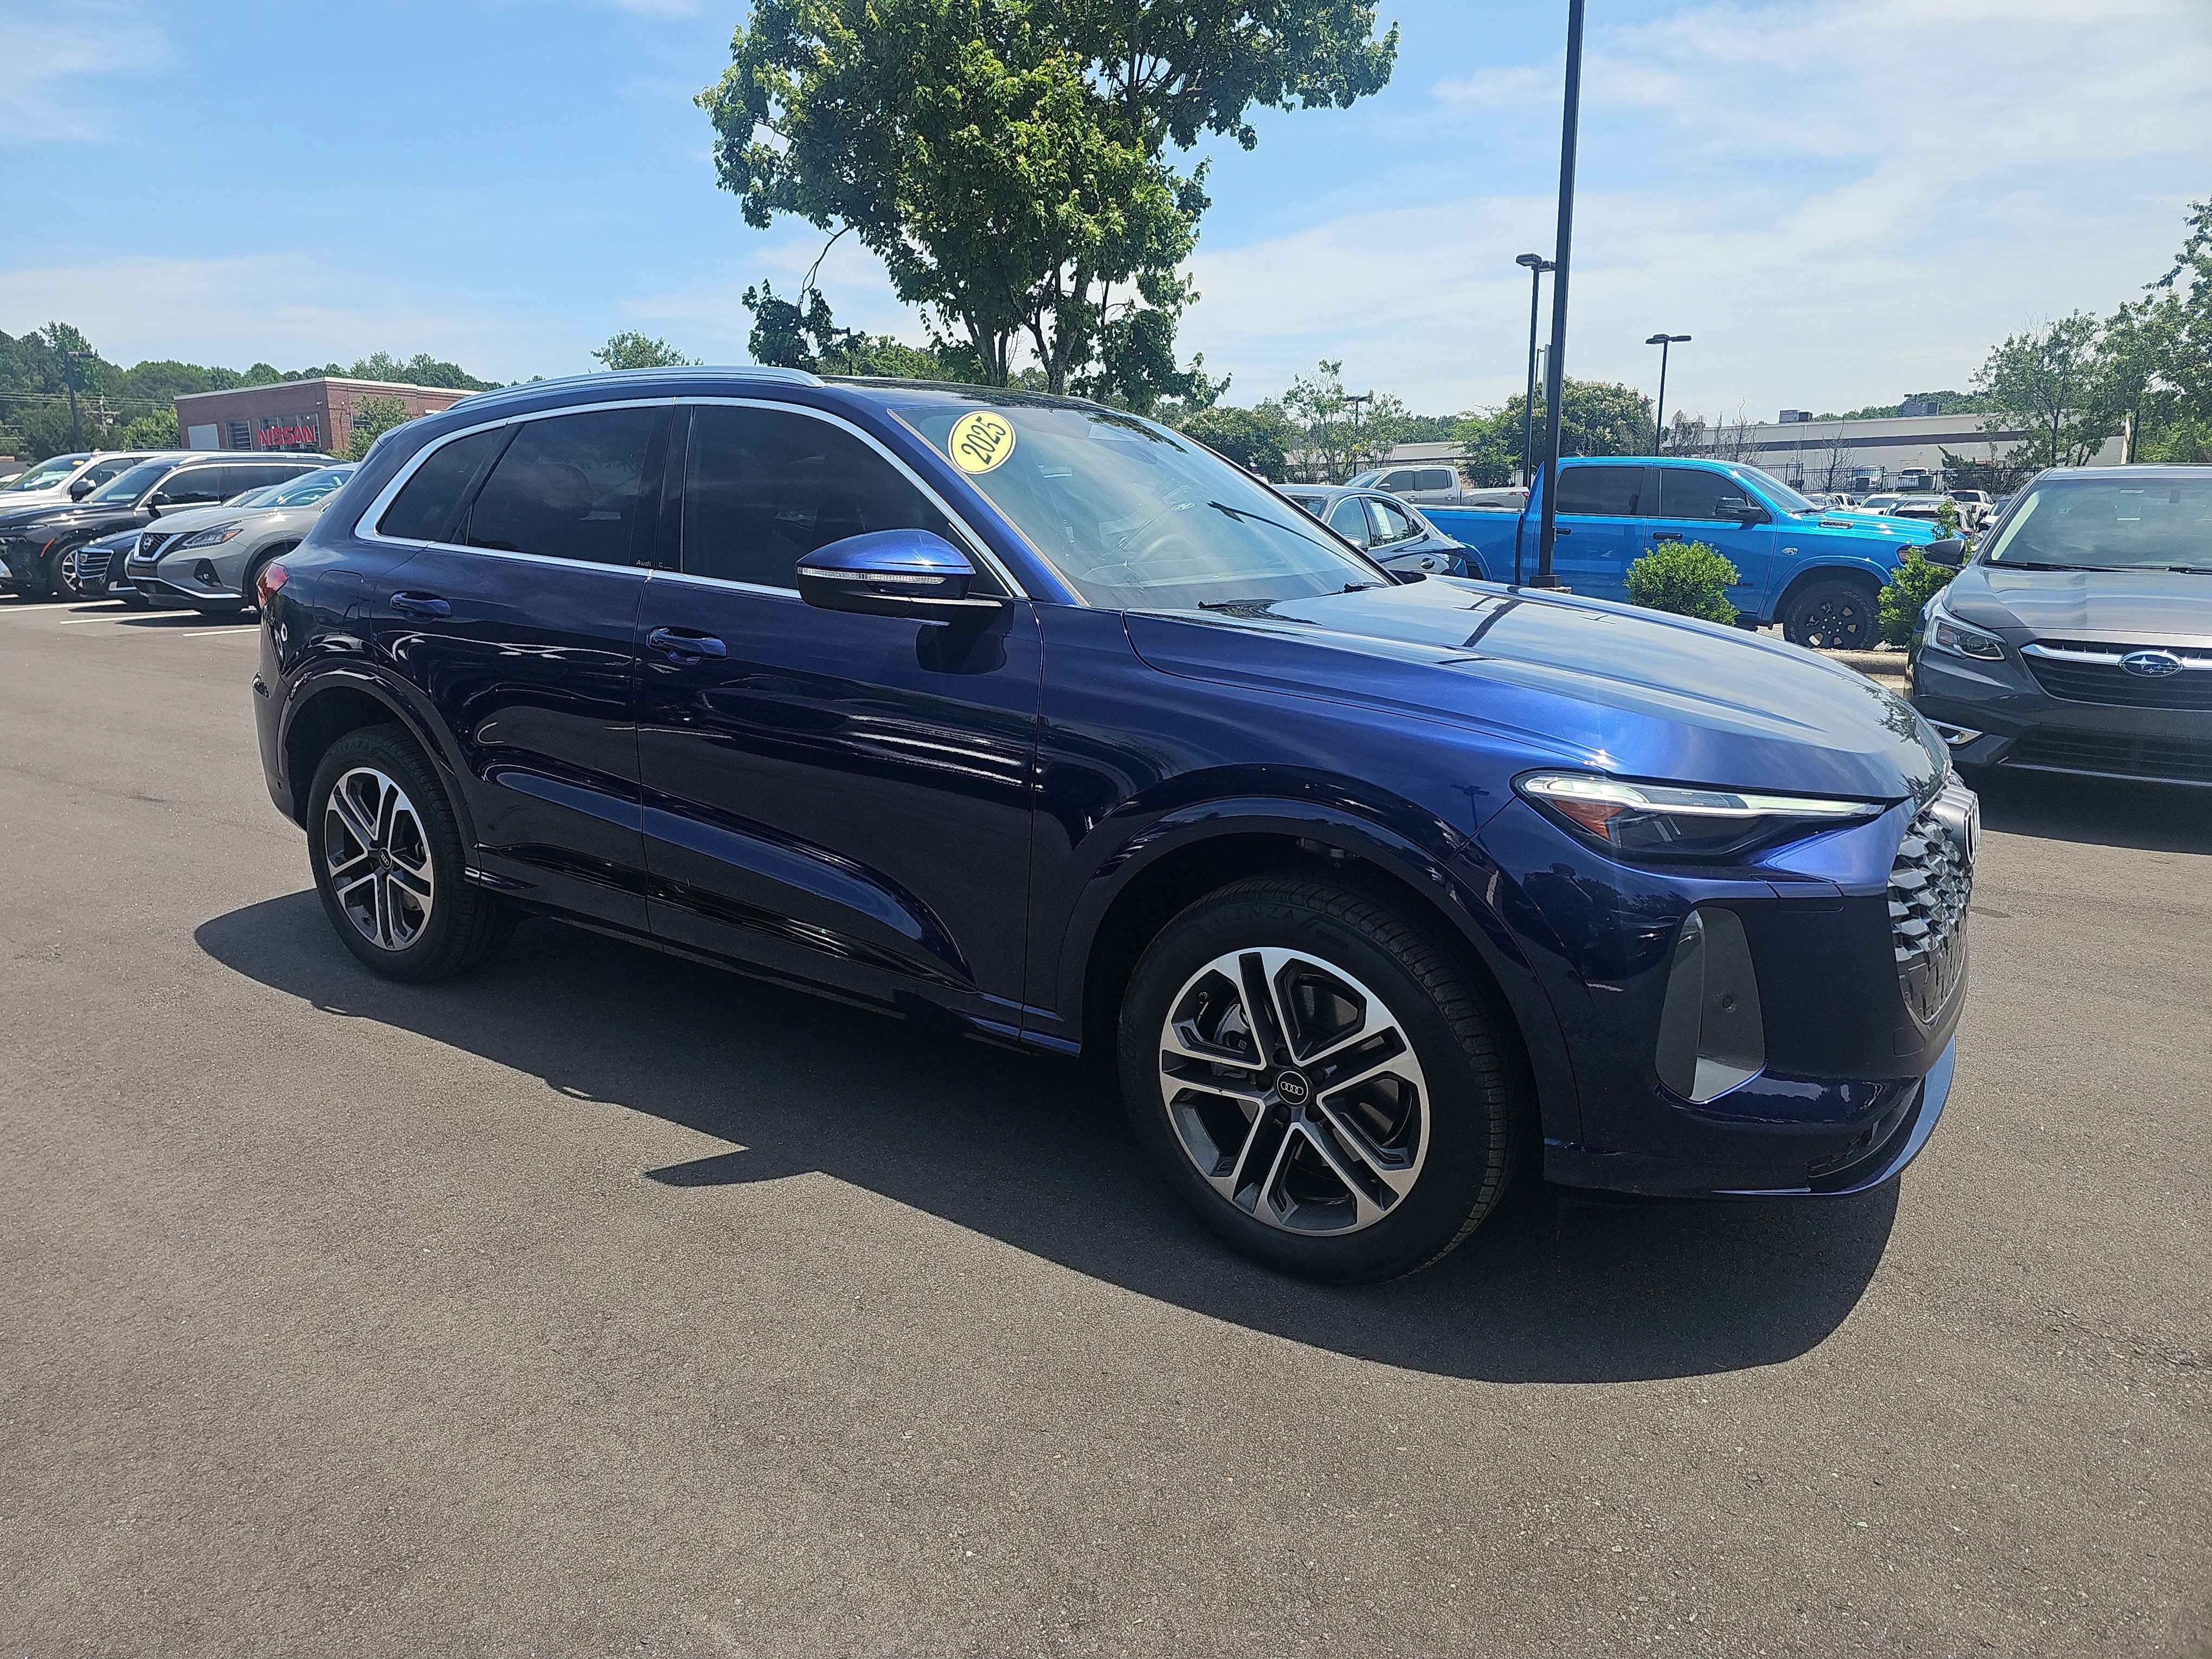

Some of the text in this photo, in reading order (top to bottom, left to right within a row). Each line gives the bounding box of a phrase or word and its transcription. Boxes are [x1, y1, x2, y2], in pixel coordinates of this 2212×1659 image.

[258, 425, 316, 446] NISSAN
[961, 415, 1006, 465] 2025
[635, 559, 652, 567] Audi
[1209, 905, 1297, 928] ALENZA
